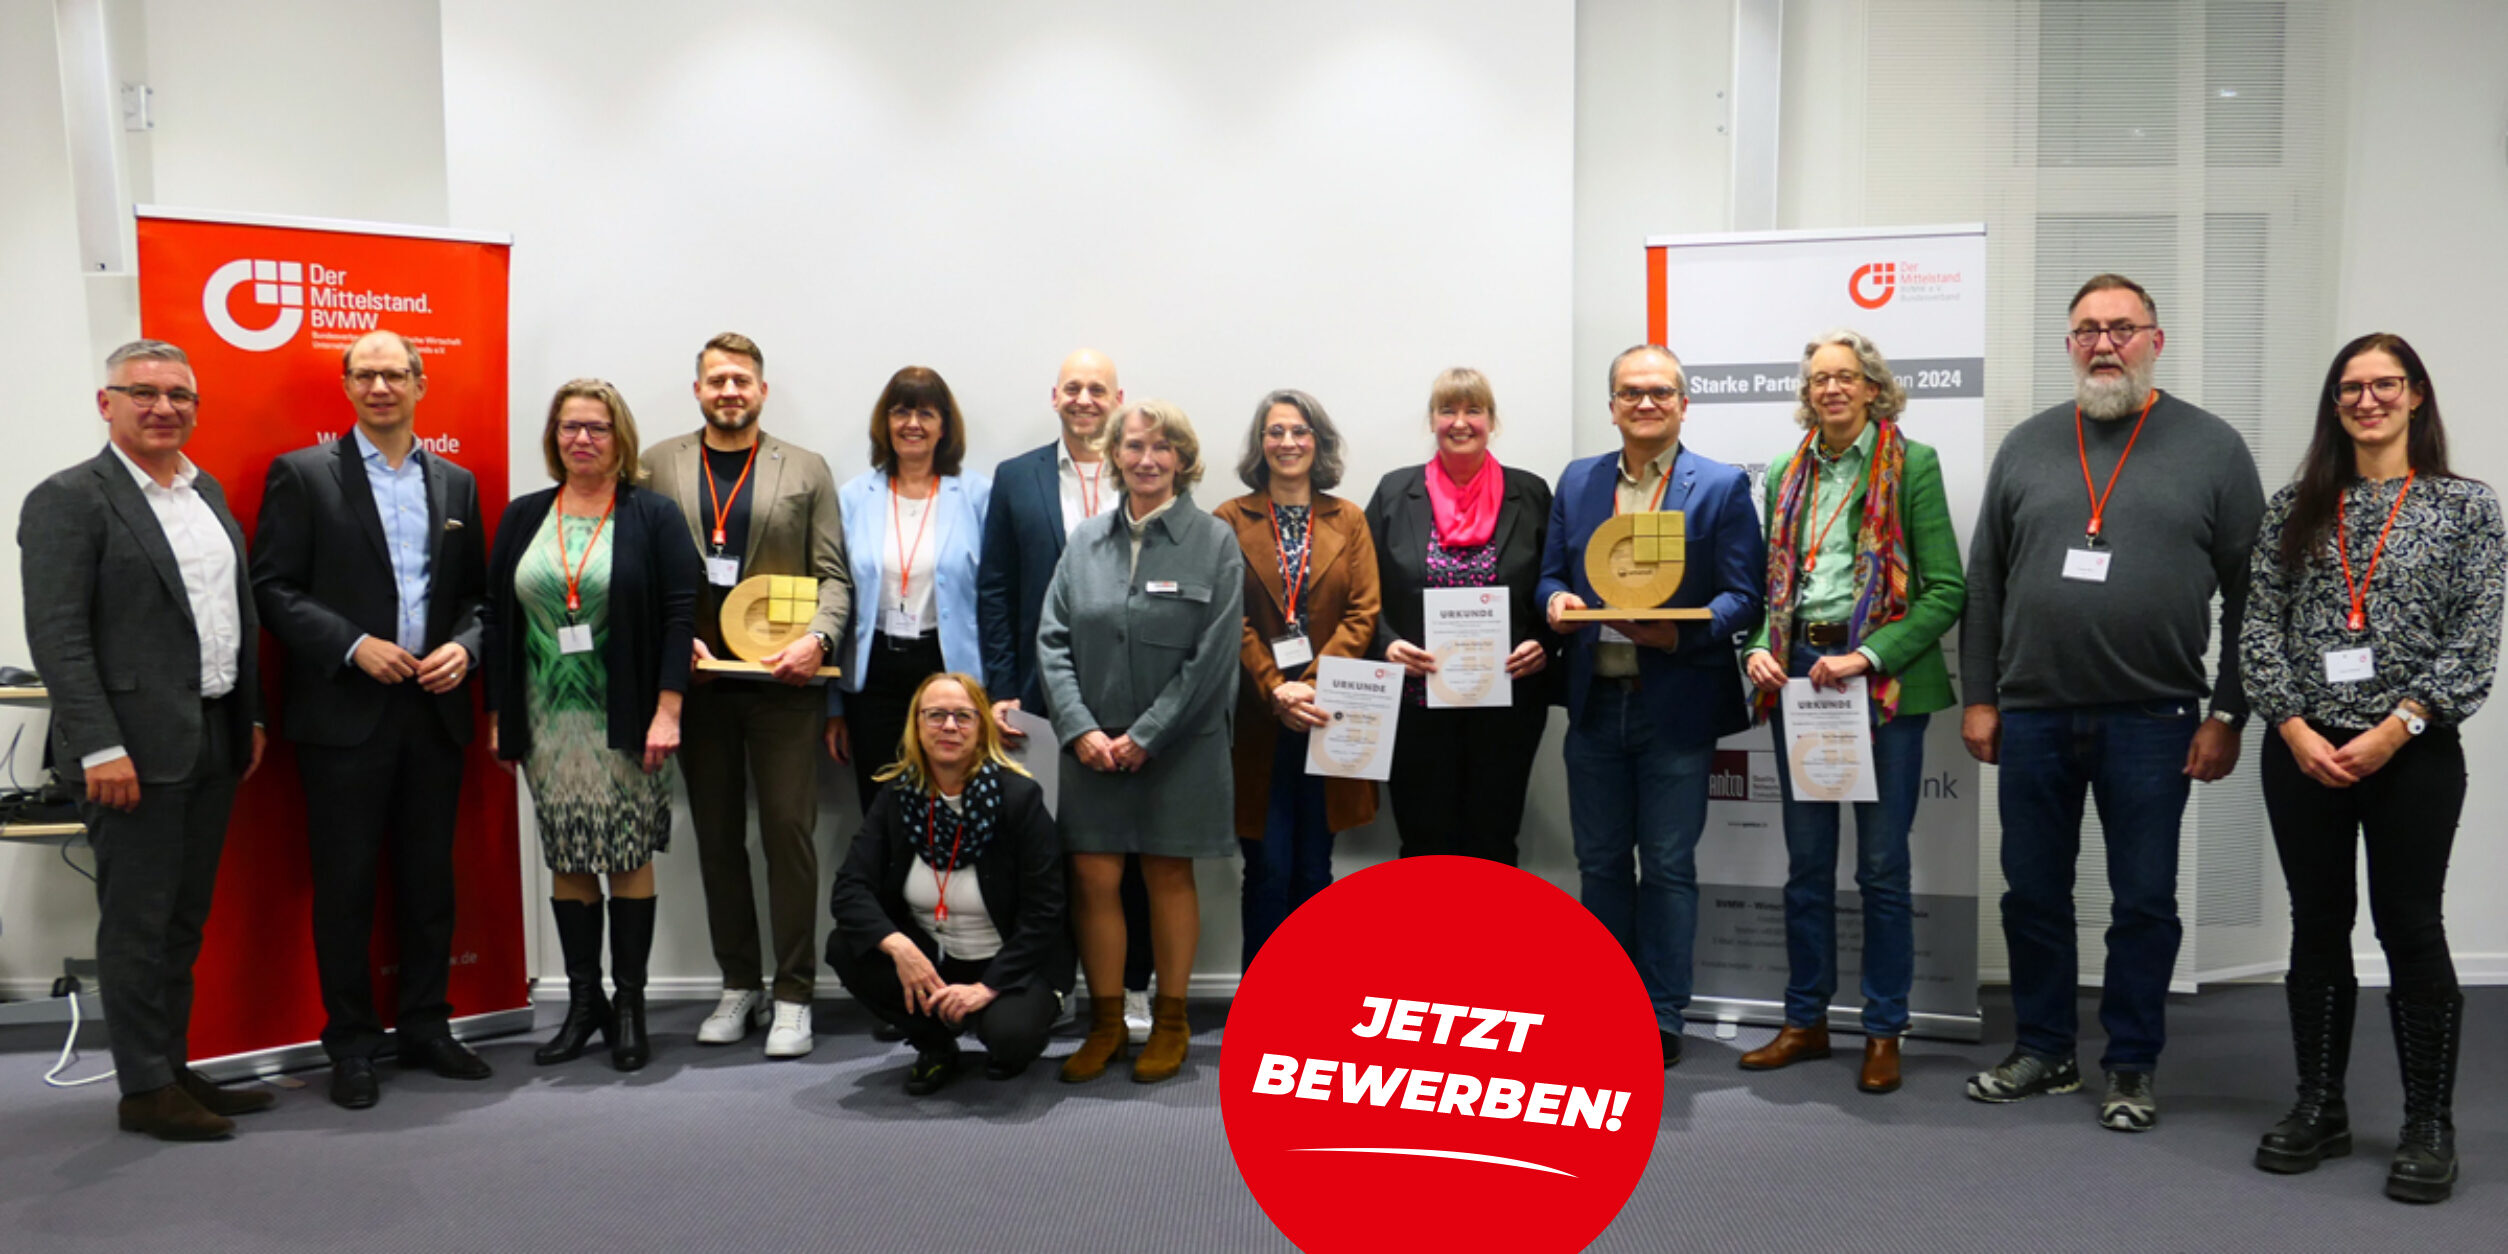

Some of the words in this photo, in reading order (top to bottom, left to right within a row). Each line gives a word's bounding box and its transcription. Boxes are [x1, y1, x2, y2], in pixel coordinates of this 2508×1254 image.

[309, 263, 347, 285] Der
[310, 286, 433, 314] Mittelstand.
[311, 309, 379, 331] BVMW
[1691, 375, 1749, 394] Starke
[1918, 369, 1962, 388] 2024
[1439, 609, 1494, 619] URKUNDE
[1333, 680, 1386, 693] URKUNDE
[1797, 700, 1852, 709] URKUNDE
